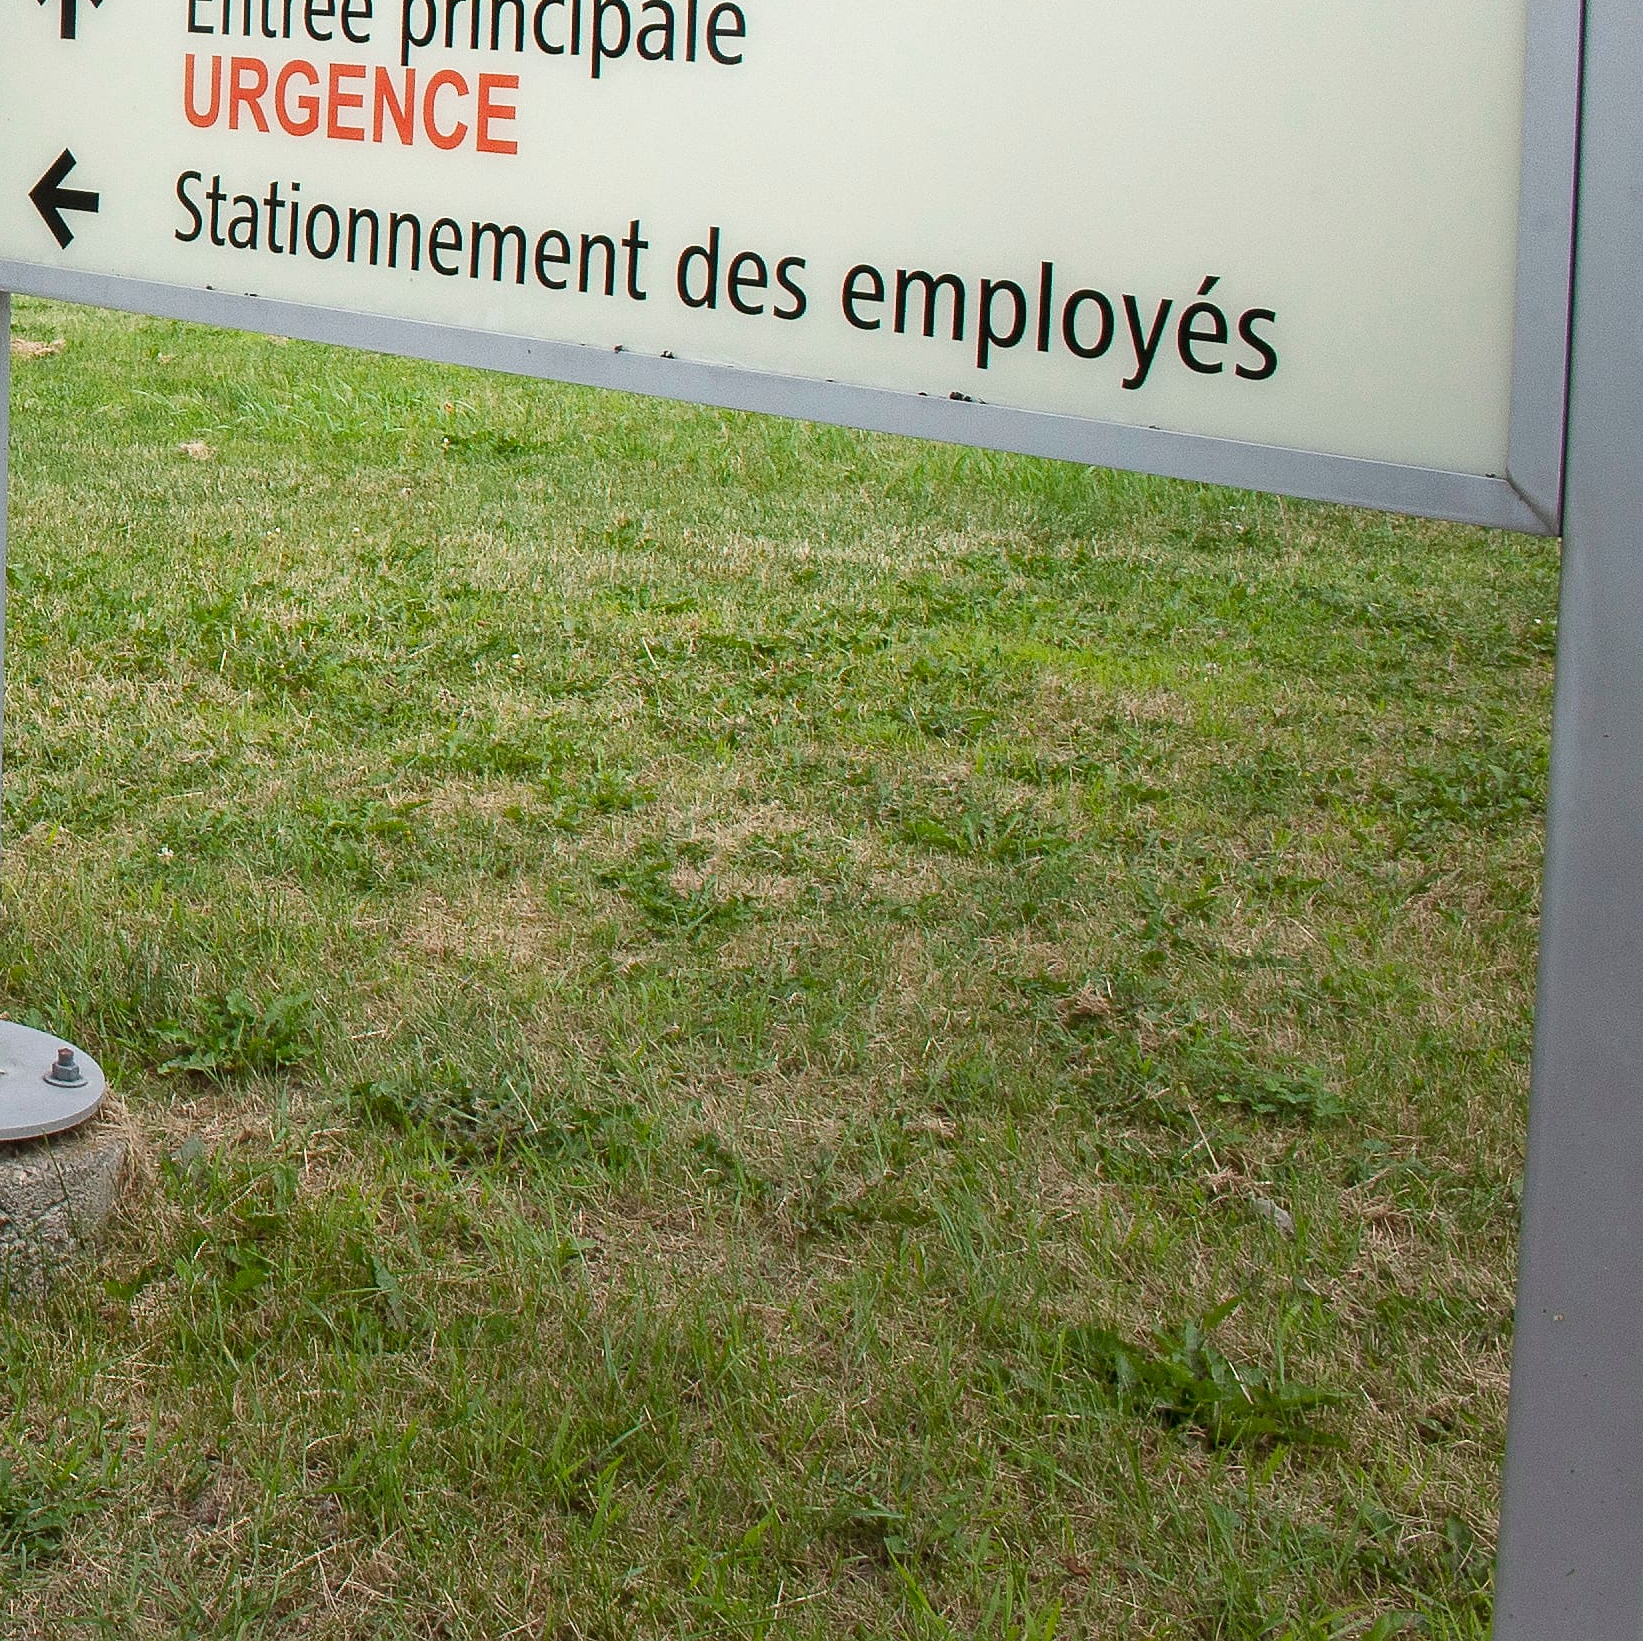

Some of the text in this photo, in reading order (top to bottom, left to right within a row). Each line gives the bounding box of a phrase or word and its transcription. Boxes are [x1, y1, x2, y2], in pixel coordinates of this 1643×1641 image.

[184, 53, 520, 155] URGENCE
[174, 170, 1278, 391] Stationnement des employés
